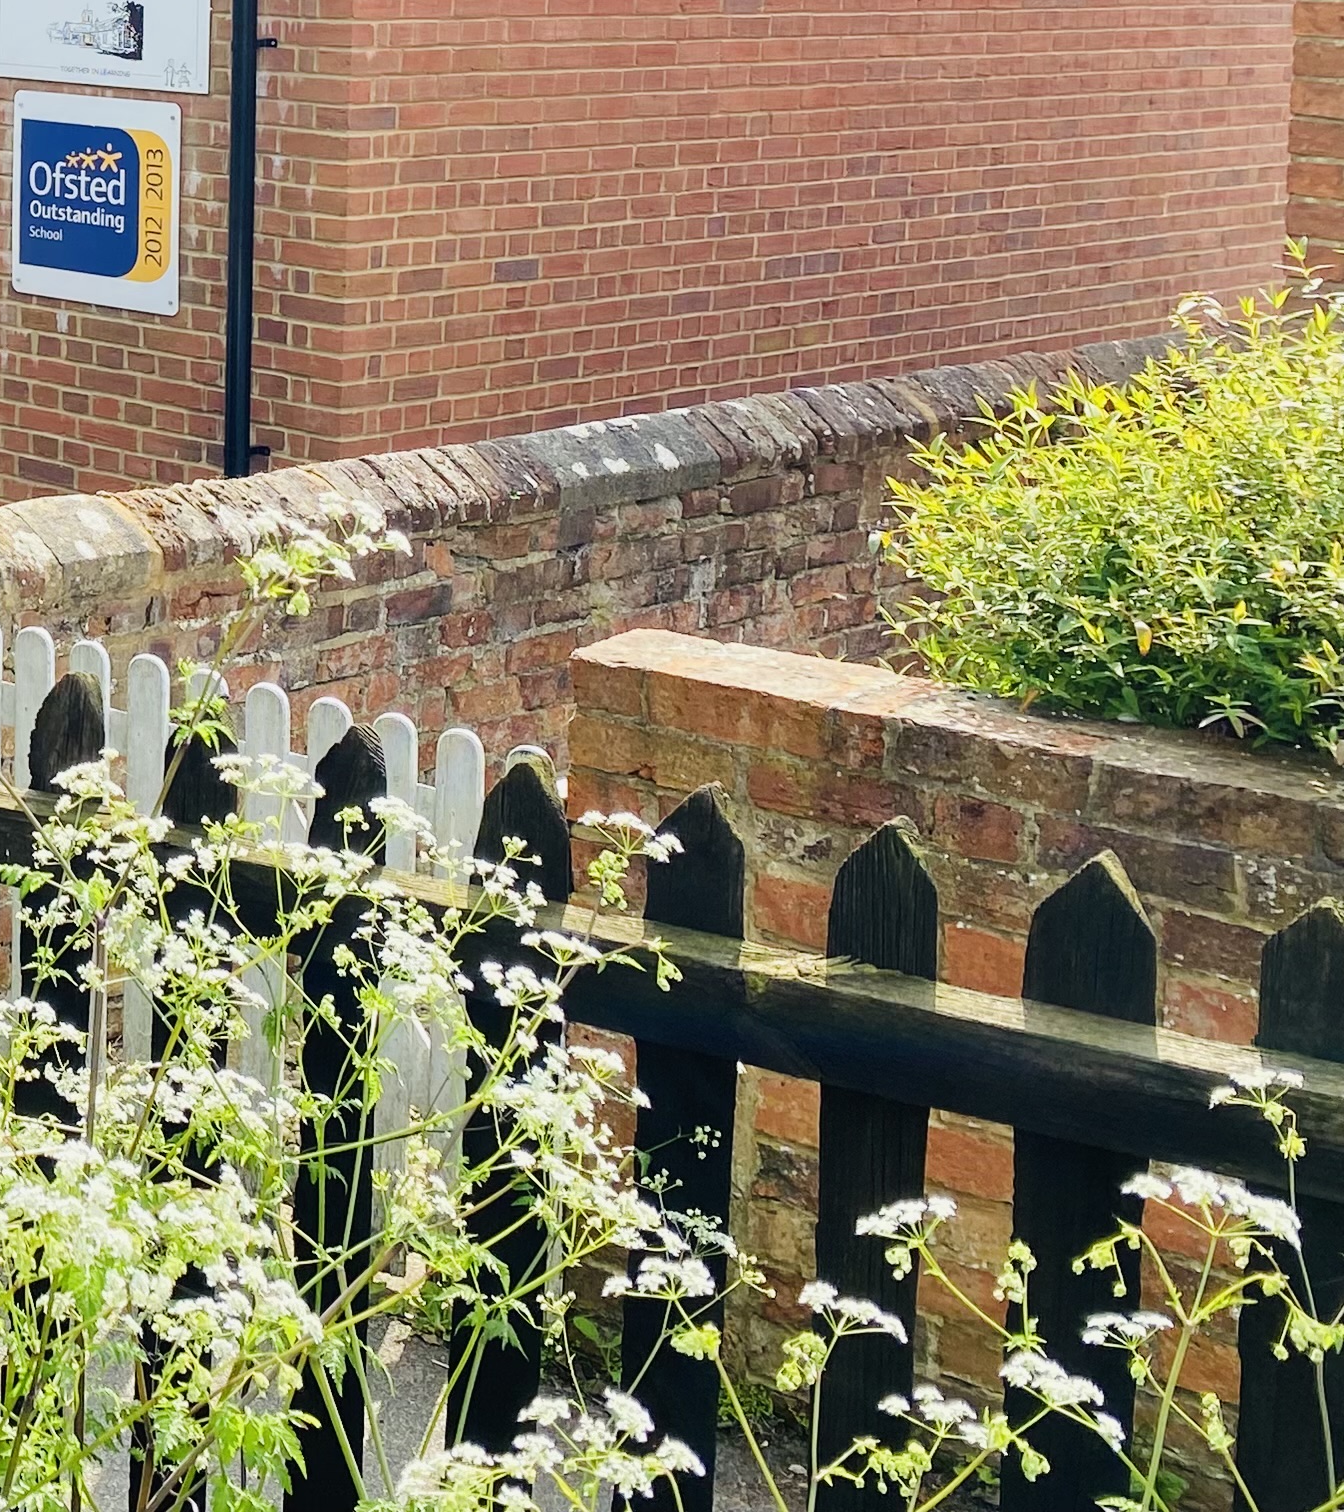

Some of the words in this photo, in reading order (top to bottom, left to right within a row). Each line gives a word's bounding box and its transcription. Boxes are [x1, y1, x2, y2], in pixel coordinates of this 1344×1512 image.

[29, 161, 126, 206] Ofsted
[145, 148, 164, 201] 2013
[29, 200, 125, 233] Outstanding
[29, 225, 63, 241] School
[144, 216, 163, 268] 2012
